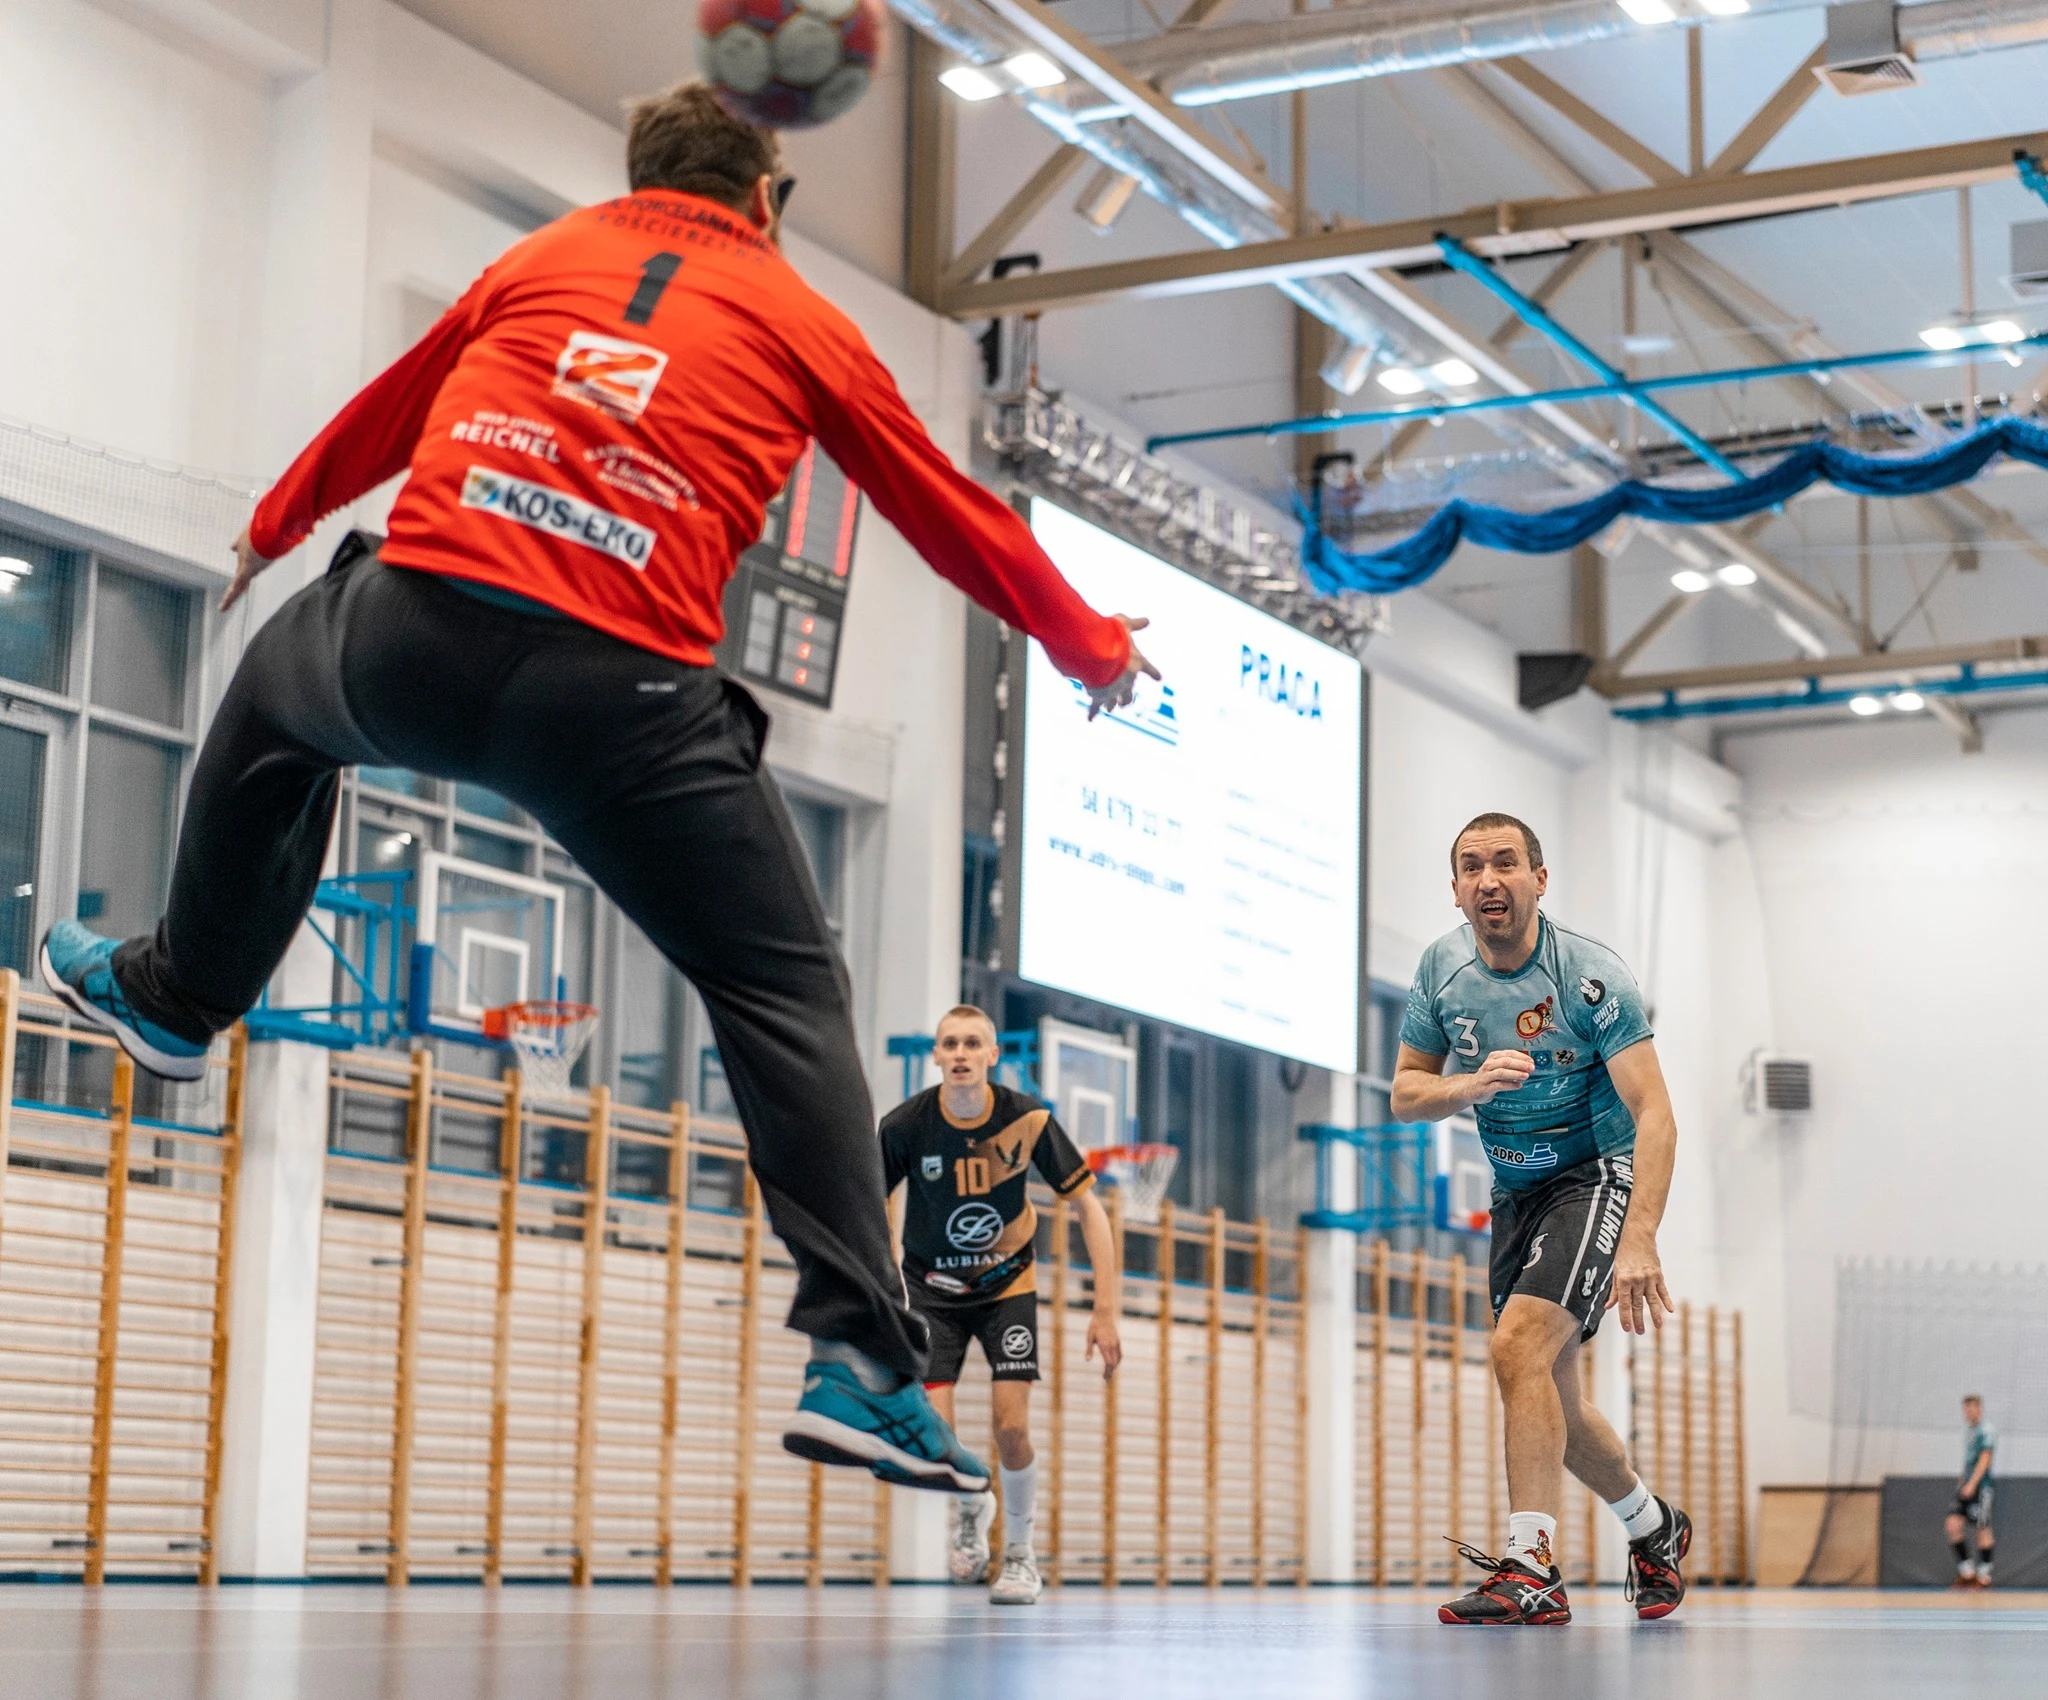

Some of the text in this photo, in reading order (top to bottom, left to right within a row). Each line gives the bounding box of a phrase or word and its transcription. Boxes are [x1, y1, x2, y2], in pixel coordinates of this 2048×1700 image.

[623, 251, 684, 327] 1
[451, 421, 561, 464] REICHEL
[504, 483, 646, 561] KOS-EKO
[1241, 644, 1323, 722] PRACA
[1592, 996, 1620, 1025] WHITE
[1453, 1015, 1480, 1057] 3
[1491, 1145, 1525, 1164] ADRO
[954, 1157, 991, 1197] 10
[1595, 1186, 1627, 1255] WHITE
[935, 1252, 1014, 1270] LUBIAN
